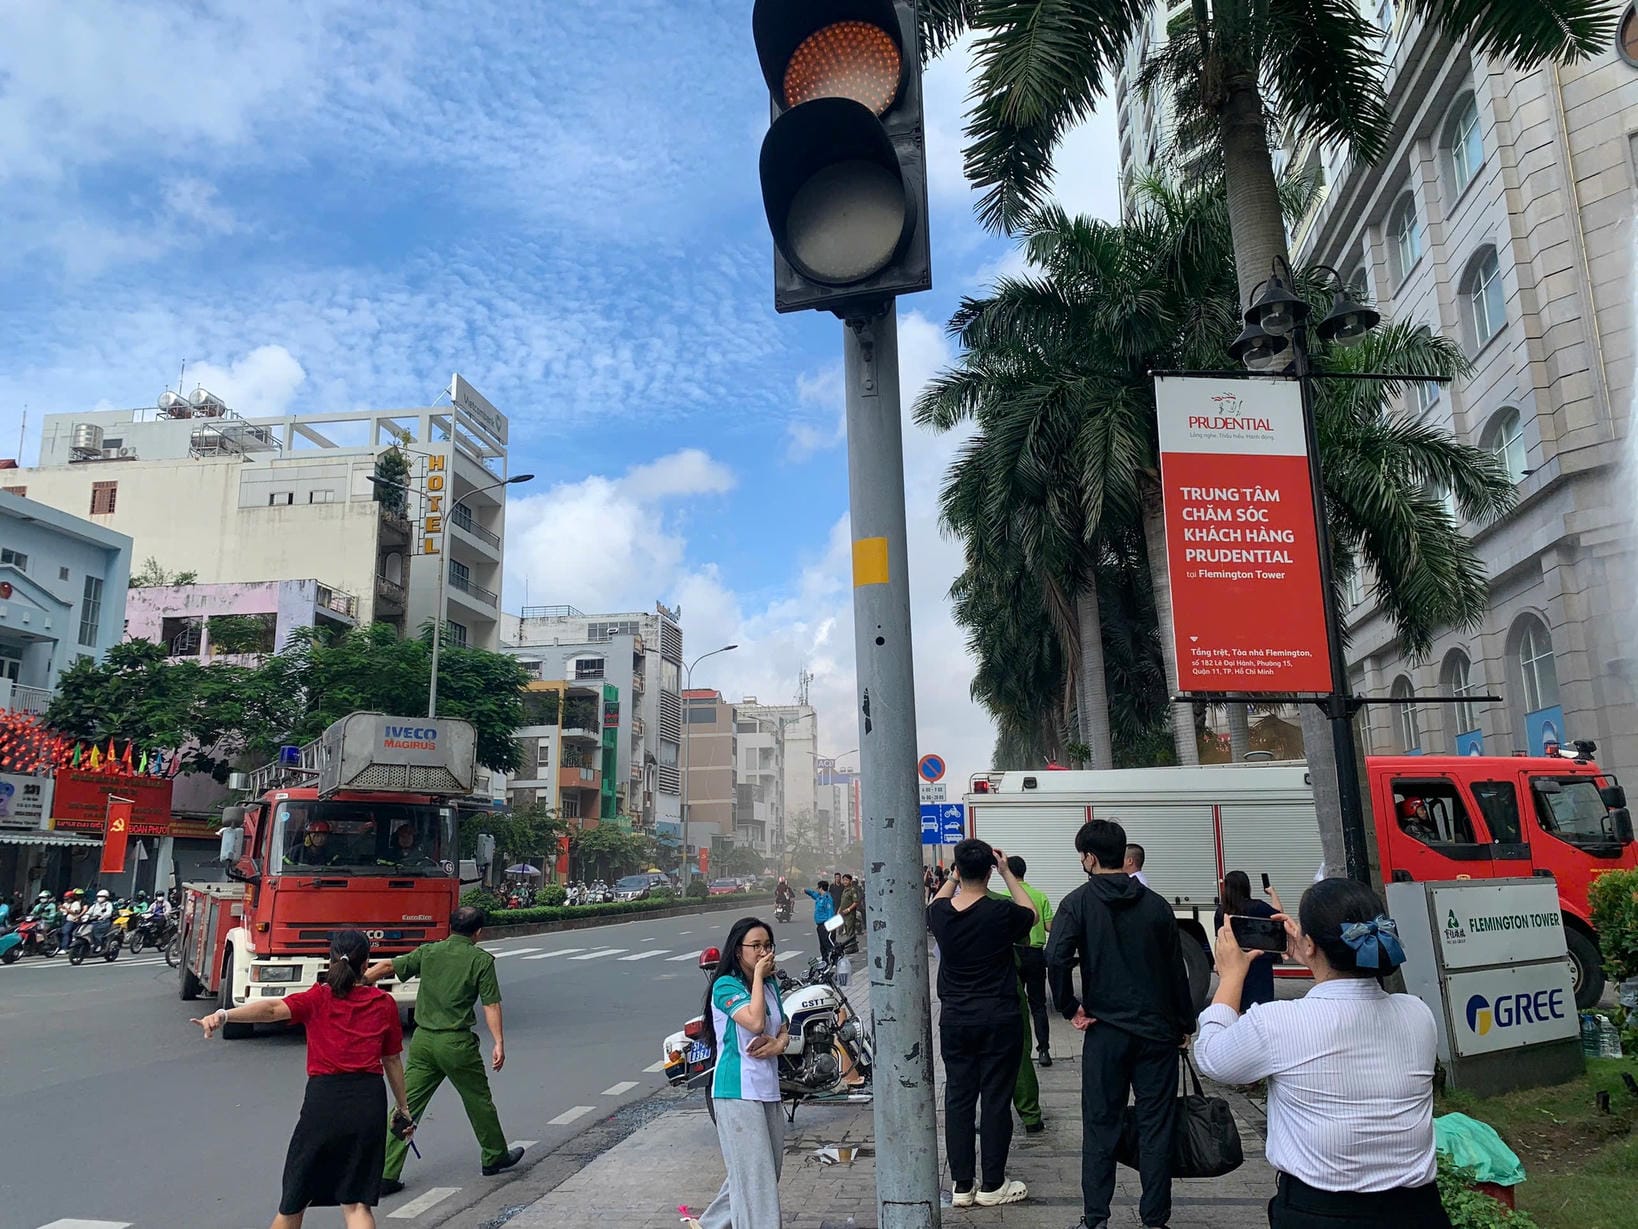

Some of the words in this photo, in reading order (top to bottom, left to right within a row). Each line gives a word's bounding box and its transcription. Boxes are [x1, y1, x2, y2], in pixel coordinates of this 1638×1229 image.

[1188, 415, 1274, 431] PRUDENTIAL
[1179, 487, 1239, 502] TRUNG
[1242, 485, 1281, 502] TÂM
[424, 454, 445, 556] HOTEL
[1182, 504, 1233, 521] CHĂM
[1236, 505, 1269, 522] SÓC
[1184, 525, 1242, 542] KHÁCH
[1246, 526, 1295, 543] HÀNG
[1185, 548, 1294, 563] PRUDENTIAL
[1186, 570, 1197, 579] tại
[1198, 569, 1254, 581] Flemington
[1255, 570, 1286, 579] Tower
[1191, 647, 1212, 658] Tầng
[1248, 648, 1264, 657] nhà
[1265, 648, 1313, 658] Flemington,
[1283, 660, 1293, 668] 15,
[1211, 668, 1222, 676] 11,
[385, 725, 438, 740] IVECO
[384, 739, 437, 751] MAGIRUS
[1469, 914, 1530, 933] FLEMINGTON
[1530, 912, 1561, 928] TOWER
[801, 998, 825, 1008] CSTT
[1494, 988, 1565, 1028] GREE
